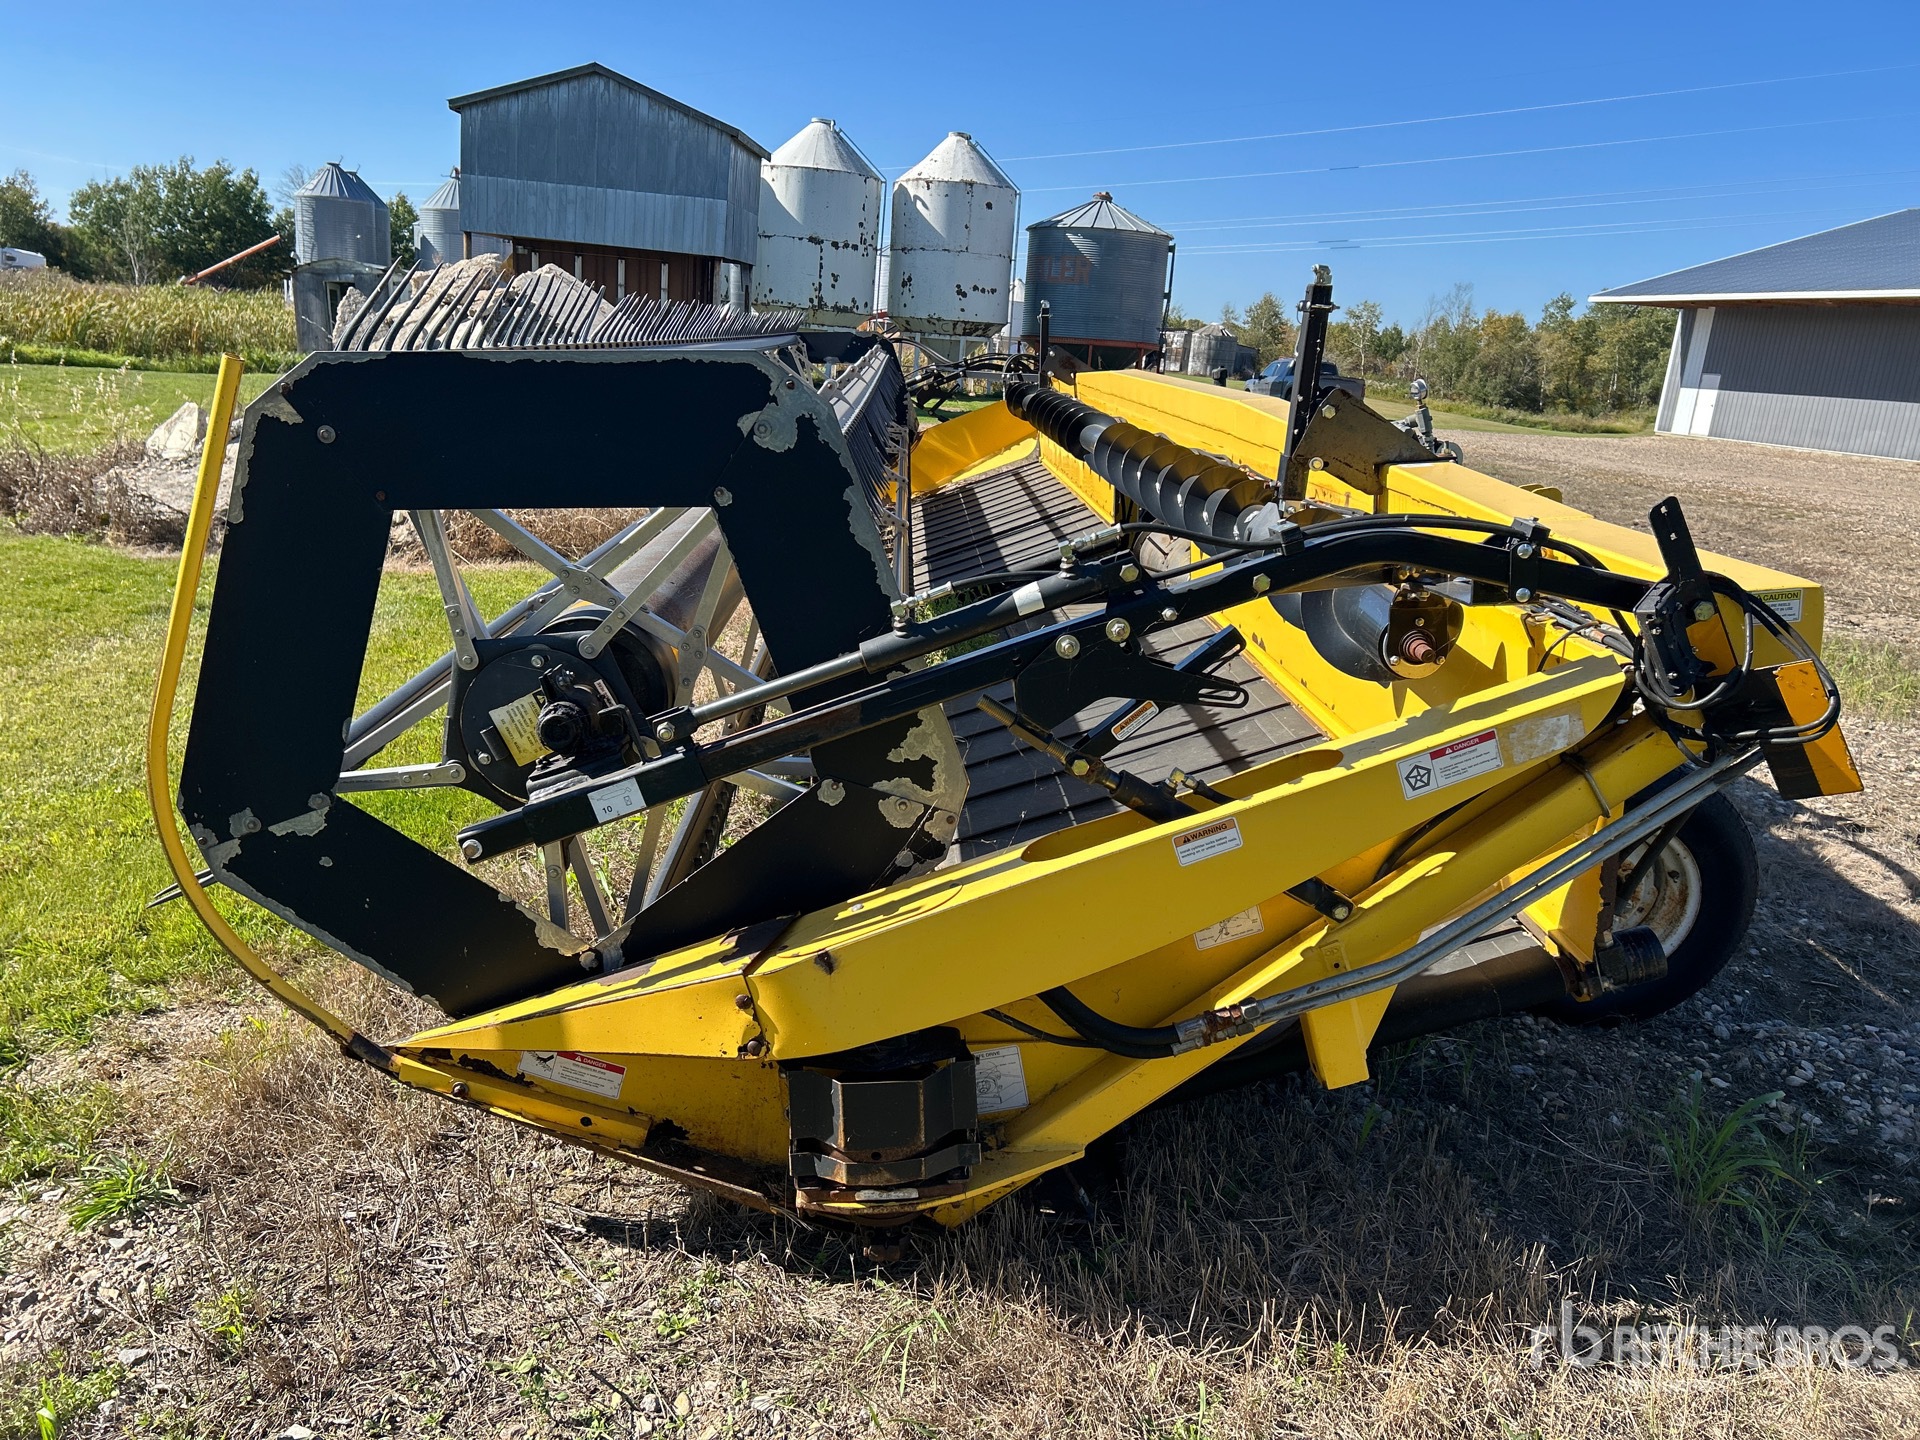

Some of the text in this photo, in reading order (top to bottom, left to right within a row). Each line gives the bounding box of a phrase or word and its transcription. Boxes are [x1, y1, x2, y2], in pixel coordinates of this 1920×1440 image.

[1763, 592, 1798, 601] CAUTION
[1123, 706, 1148, 726] WARNING
[1453, 738, 1479, 751] DANGER
[602, 805, 613, 814] 10
[1190, 823, 1228, 840] WARNING
[583, 1058, 607, 1068] DANGER
